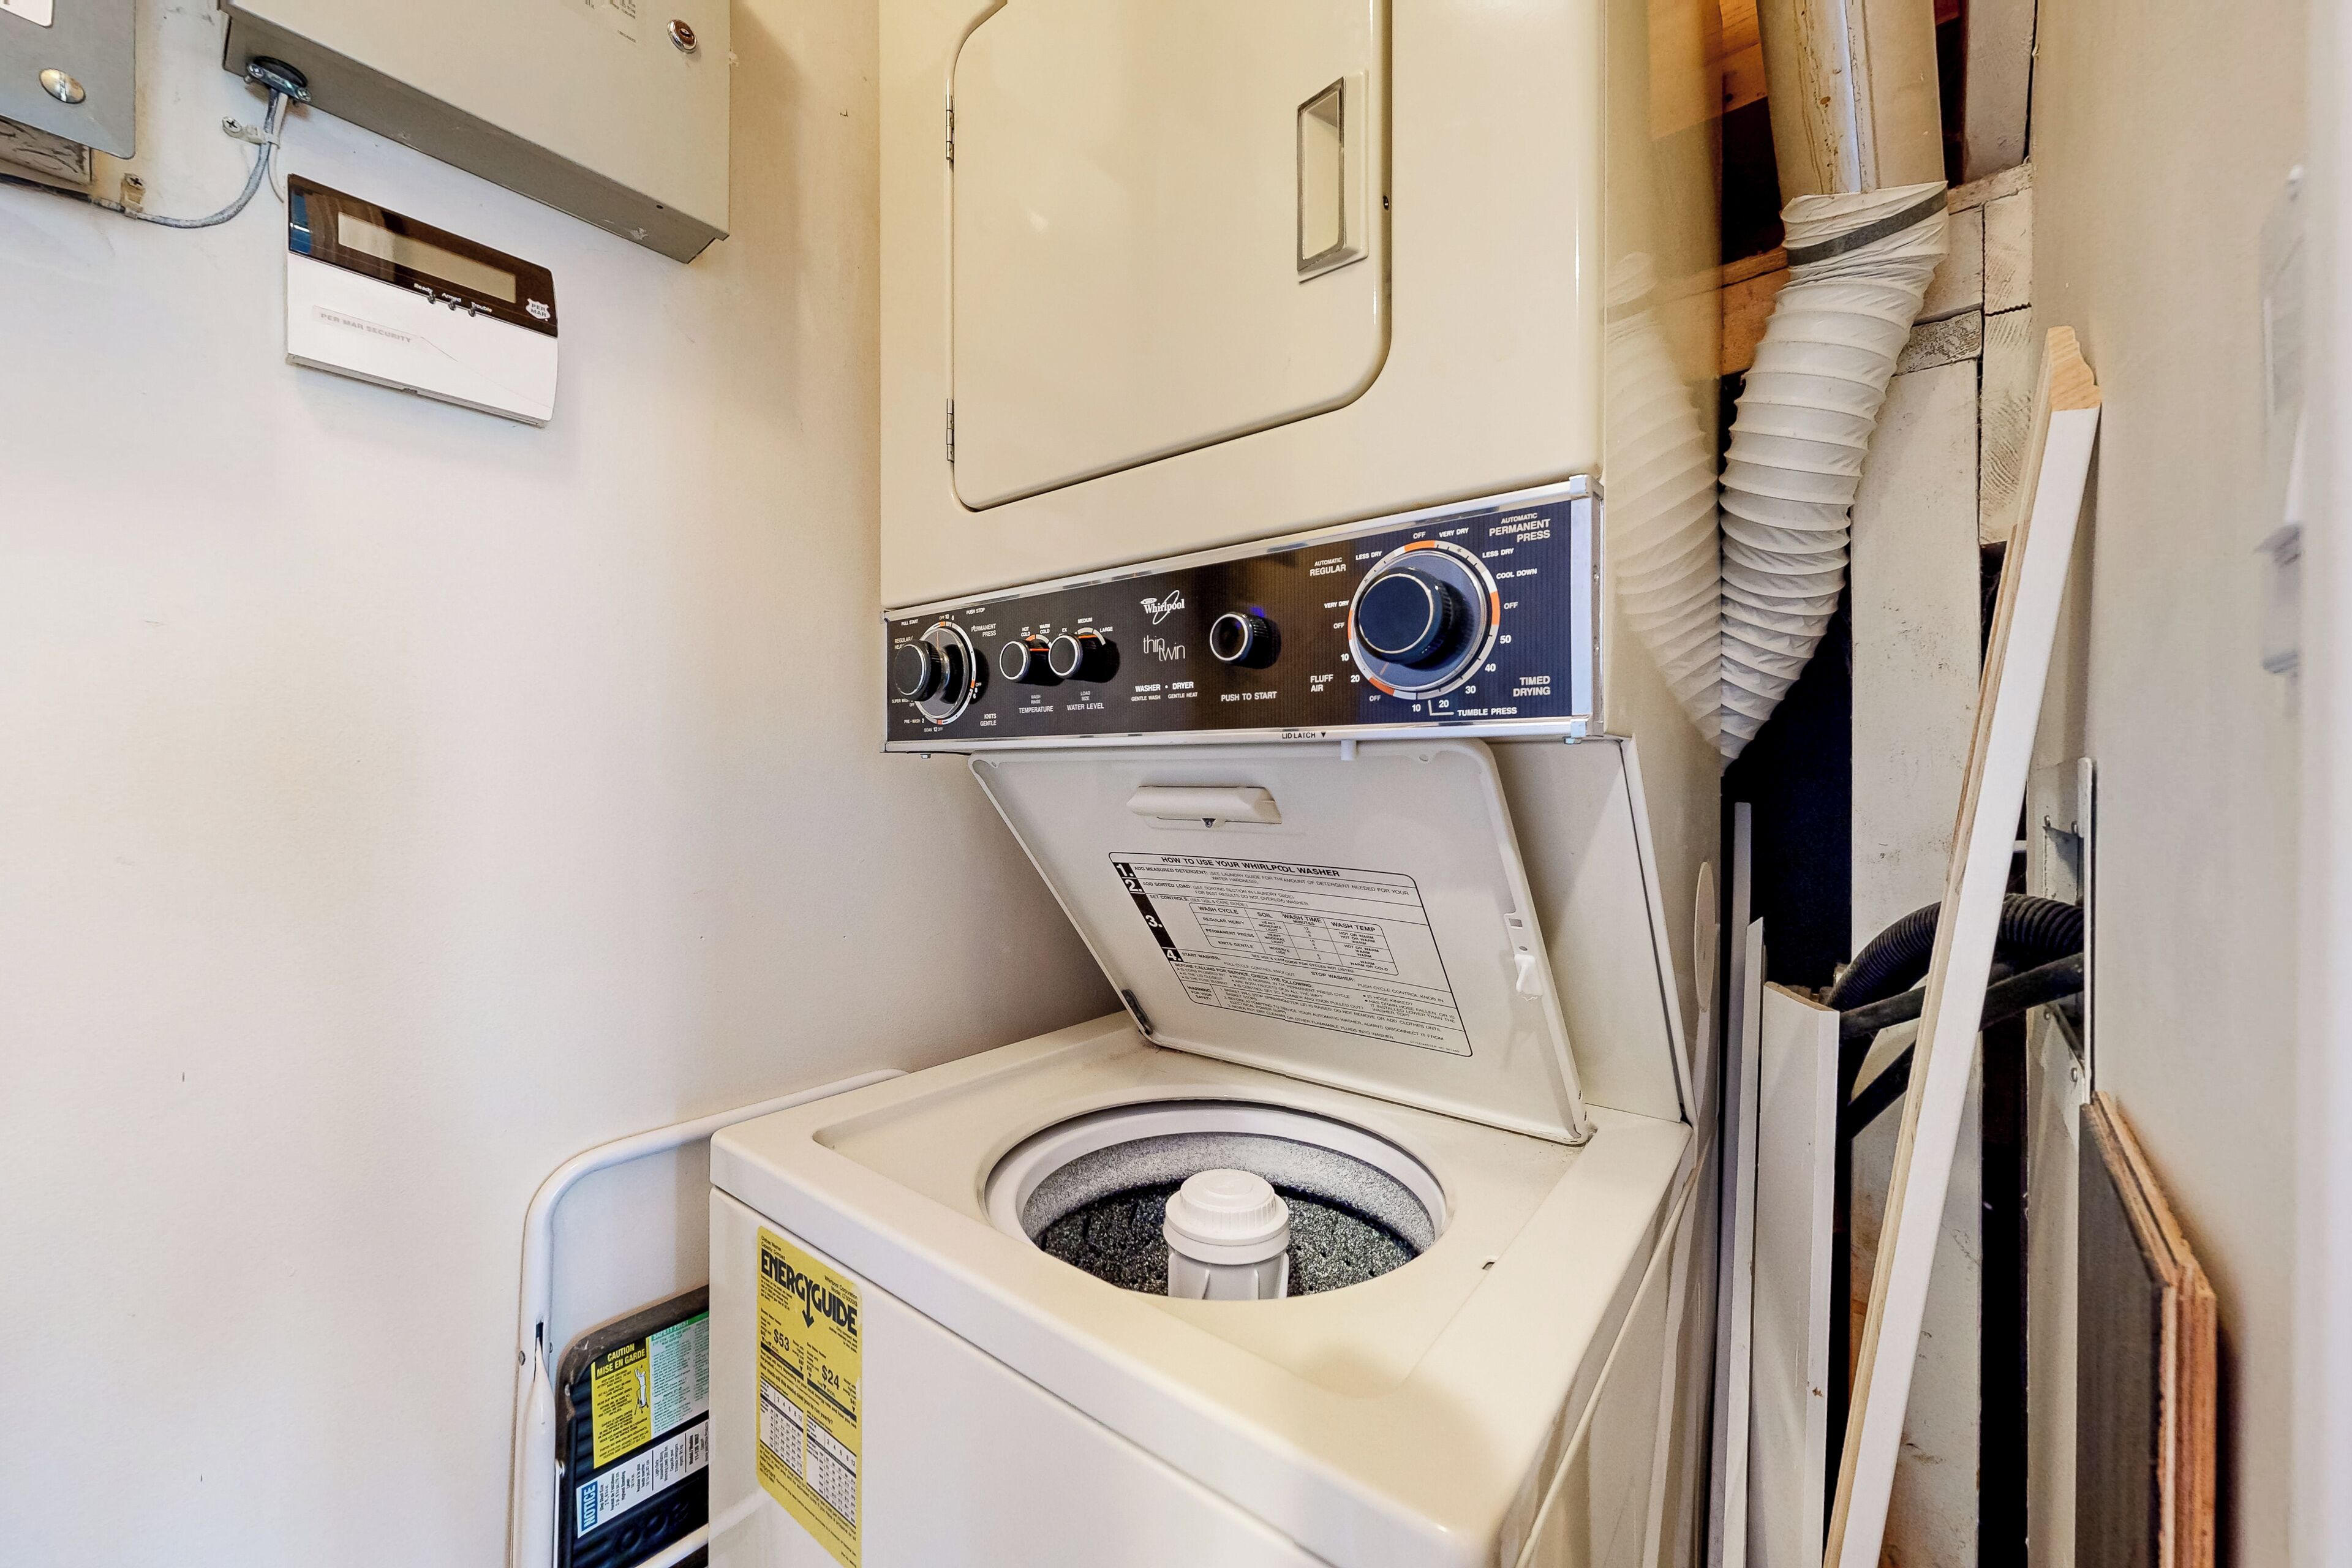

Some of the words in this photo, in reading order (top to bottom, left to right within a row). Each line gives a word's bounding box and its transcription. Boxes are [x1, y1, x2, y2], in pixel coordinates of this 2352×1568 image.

[530, 308, 546, 317] MAR
[532, 303, 546, 312] PER
[321, 313, 340, 323] PER
[342, 319, 364, 330] MAR
[366, 326, 410, 343] SECURITY
[1501, 513, 1537, 524] AUTOMATIC
[1439, 529, 1454, 538] VERY
[1456, 527, 1469, 535] DRY
[1489, 519, 1551, 537] PERMANENT
[1517, 529, 1550, 543] PRESS
[1482, 549, 1499, 558] LESS
[1501, 548, 1514, 556] DRY
[1314, 557, 1342, 567] AUTOMATIC
[1310, 564, 1346, 577] REGULAR
[1496, 571, 1515, 579] COOL
[1517, 568, 1537, 577] DOWN
[1143, 635, 1165, 654] thin
[1500, 635, 1512, 644] 50
[1158, 642, 1186, 662] twin
[1485, 663, 1496, 672] 40
[1310, 674, 1333, 683] FLUFF
[1519, 676, 1550, 686] TIMED
[1172, 681, 1194, 690] DRYER
[1465, 685, 1476, 694] 30
[1513, 686, 1551, 696] DRYING
[1221, 693, 1240, 702] PUSH
[1254, 691, 1277, 699] START
[1439, 699, 1449, 708] 20
[1457, 708, 1488, 717] TUMBLE
[1491, 707, 1517, 715] PRESS
[1116, 864, 1134, 876] 1.
[1297, 867, 1340, 877] WASHER
[1125, 879, 1143, 892] 2.
[1145, 914, 1163, 927] 3.
[1166, 949, 1182, 962] 4.
[761, 1248, 858, 1337] ENERGYGUIDE
[774, 1329, 790, 1351] $53
[608, 1343, 635, 1362] CAUTION
[597, 1363, 613, 1377] MISE
[615, 1359, 623, 1369] EN
[625, 1348, 645, 1364] GARDE
[821, 1365, 839, 1390] $24
[584, 1485, 595, 1528] NOTICE
